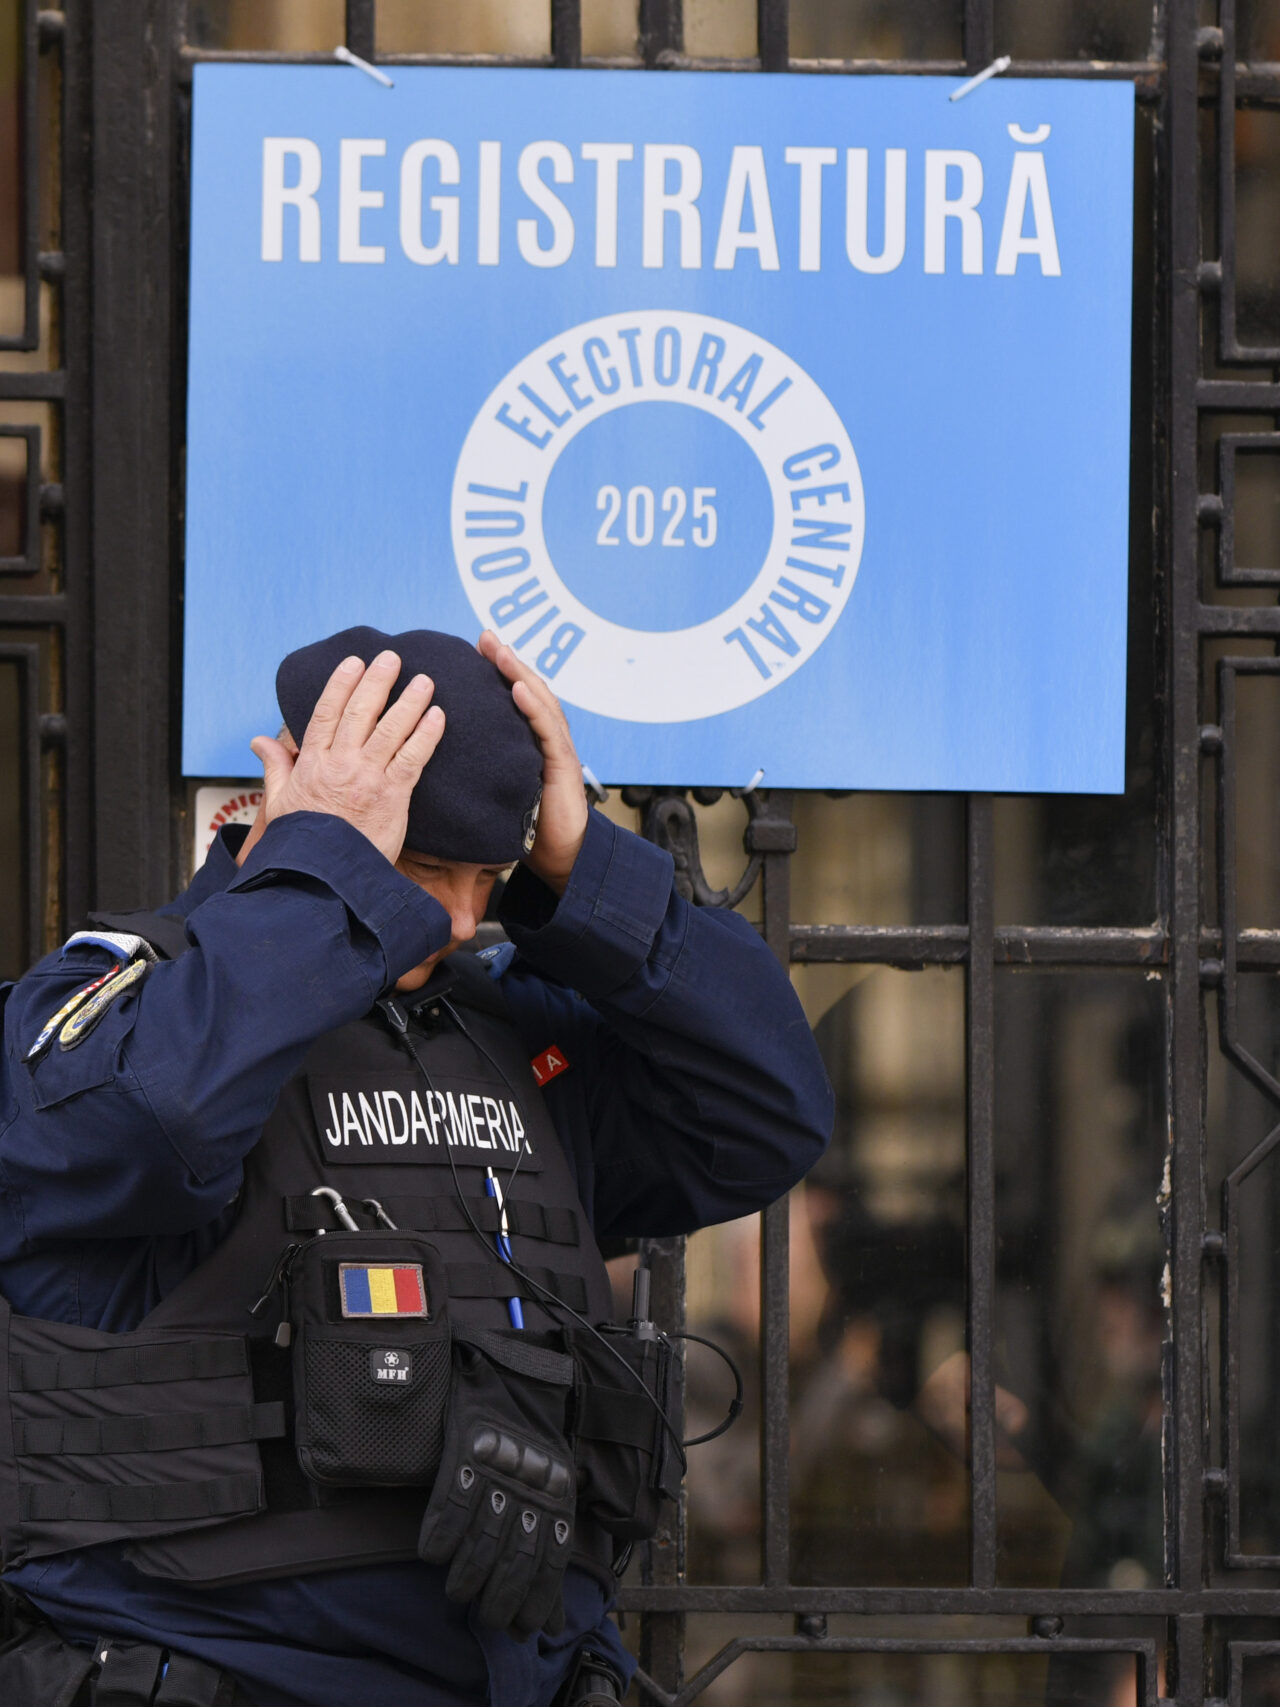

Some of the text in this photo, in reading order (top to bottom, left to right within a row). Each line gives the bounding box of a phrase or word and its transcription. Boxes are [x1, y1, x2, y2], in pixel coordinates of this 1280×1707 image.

[260, 123, 1062, 277] REGISTRATURĂ
[465, 326, 853, 680] BIROUL ELECTORAL CENTRAL
[595, 485, 718, 548] 2025
[326, 1090, 532, 1154] JANDARMERIA
